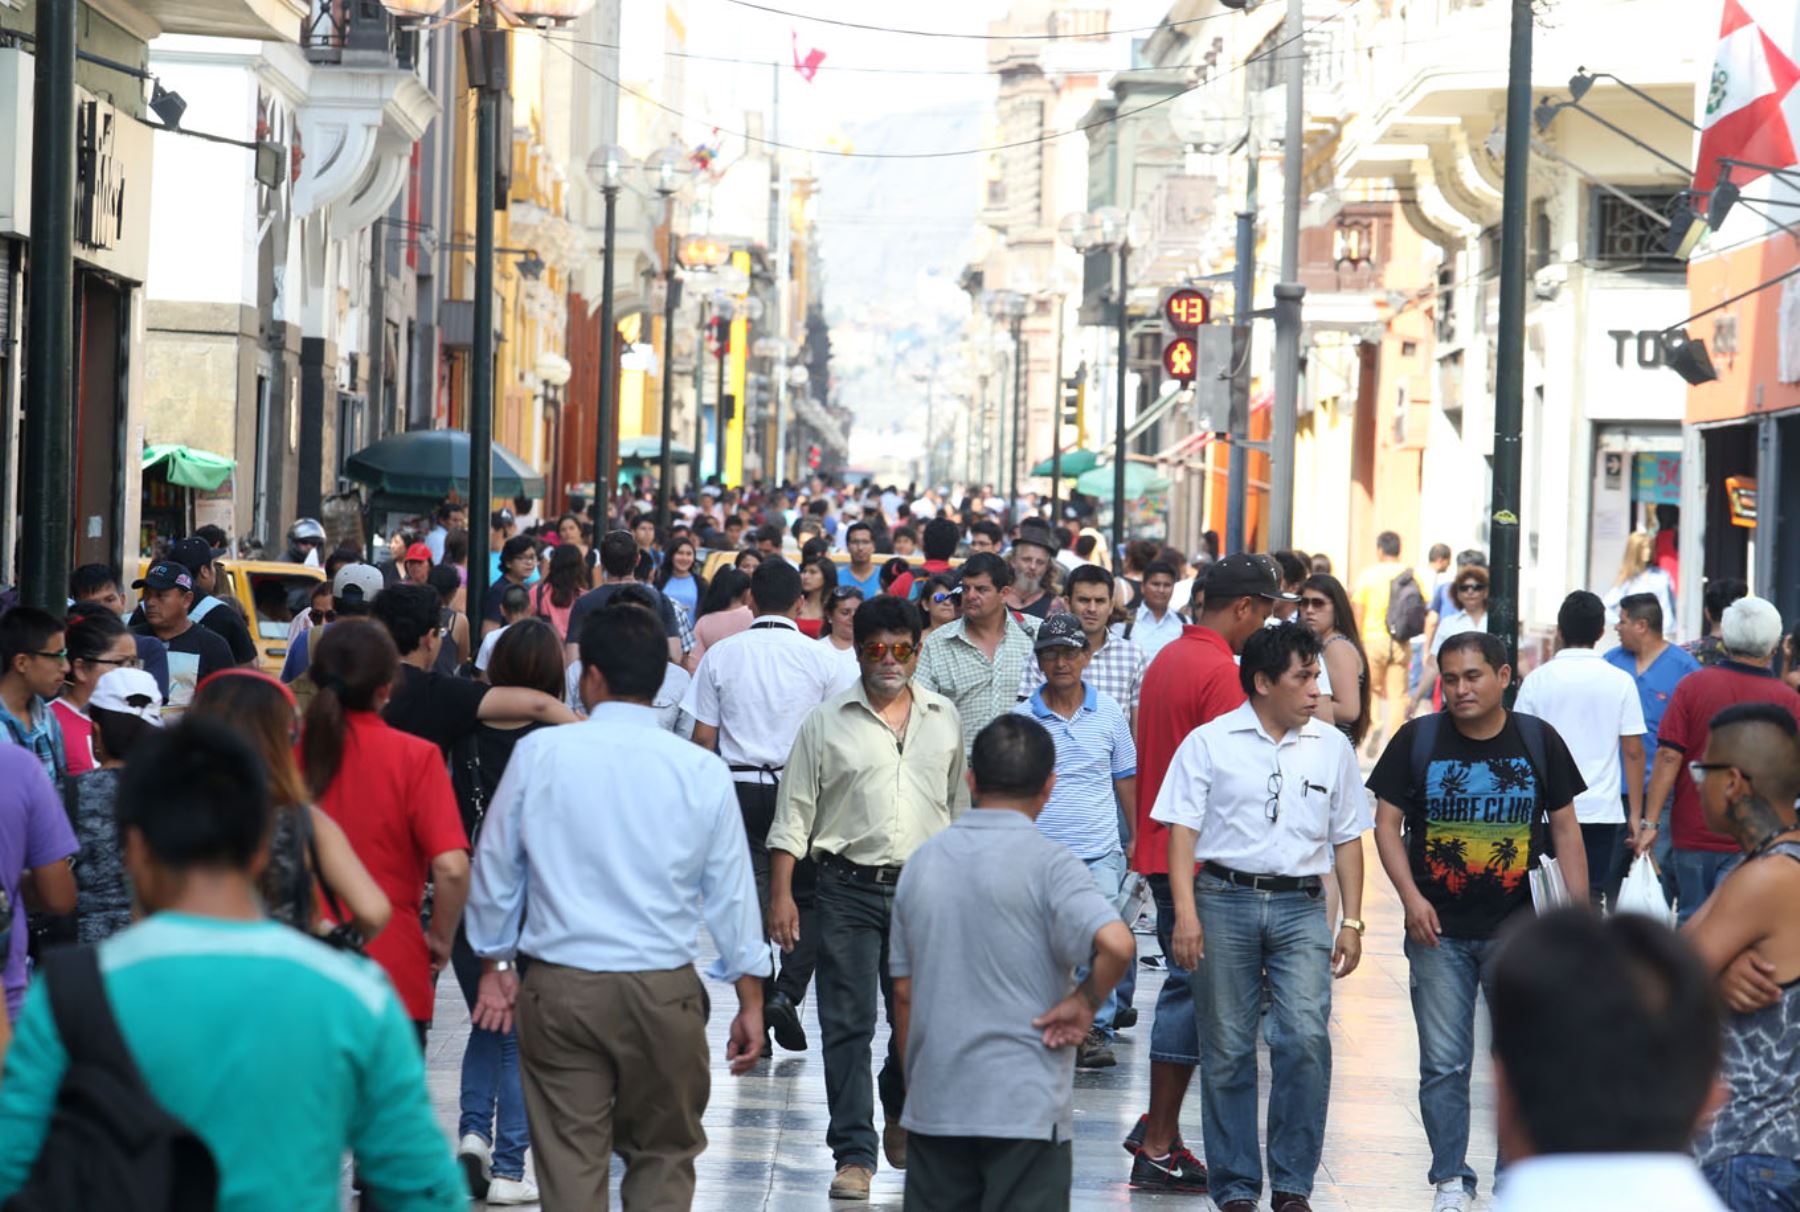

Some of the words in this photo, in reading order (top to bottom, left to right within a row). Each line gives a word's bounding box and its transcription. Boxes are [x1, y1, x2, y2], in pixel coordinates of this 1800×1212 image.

[1171, 298, 1203, 323] 43
[1429, 797, 1481, 821] SURF
[1484, 797, 1532, 823] CLUB
